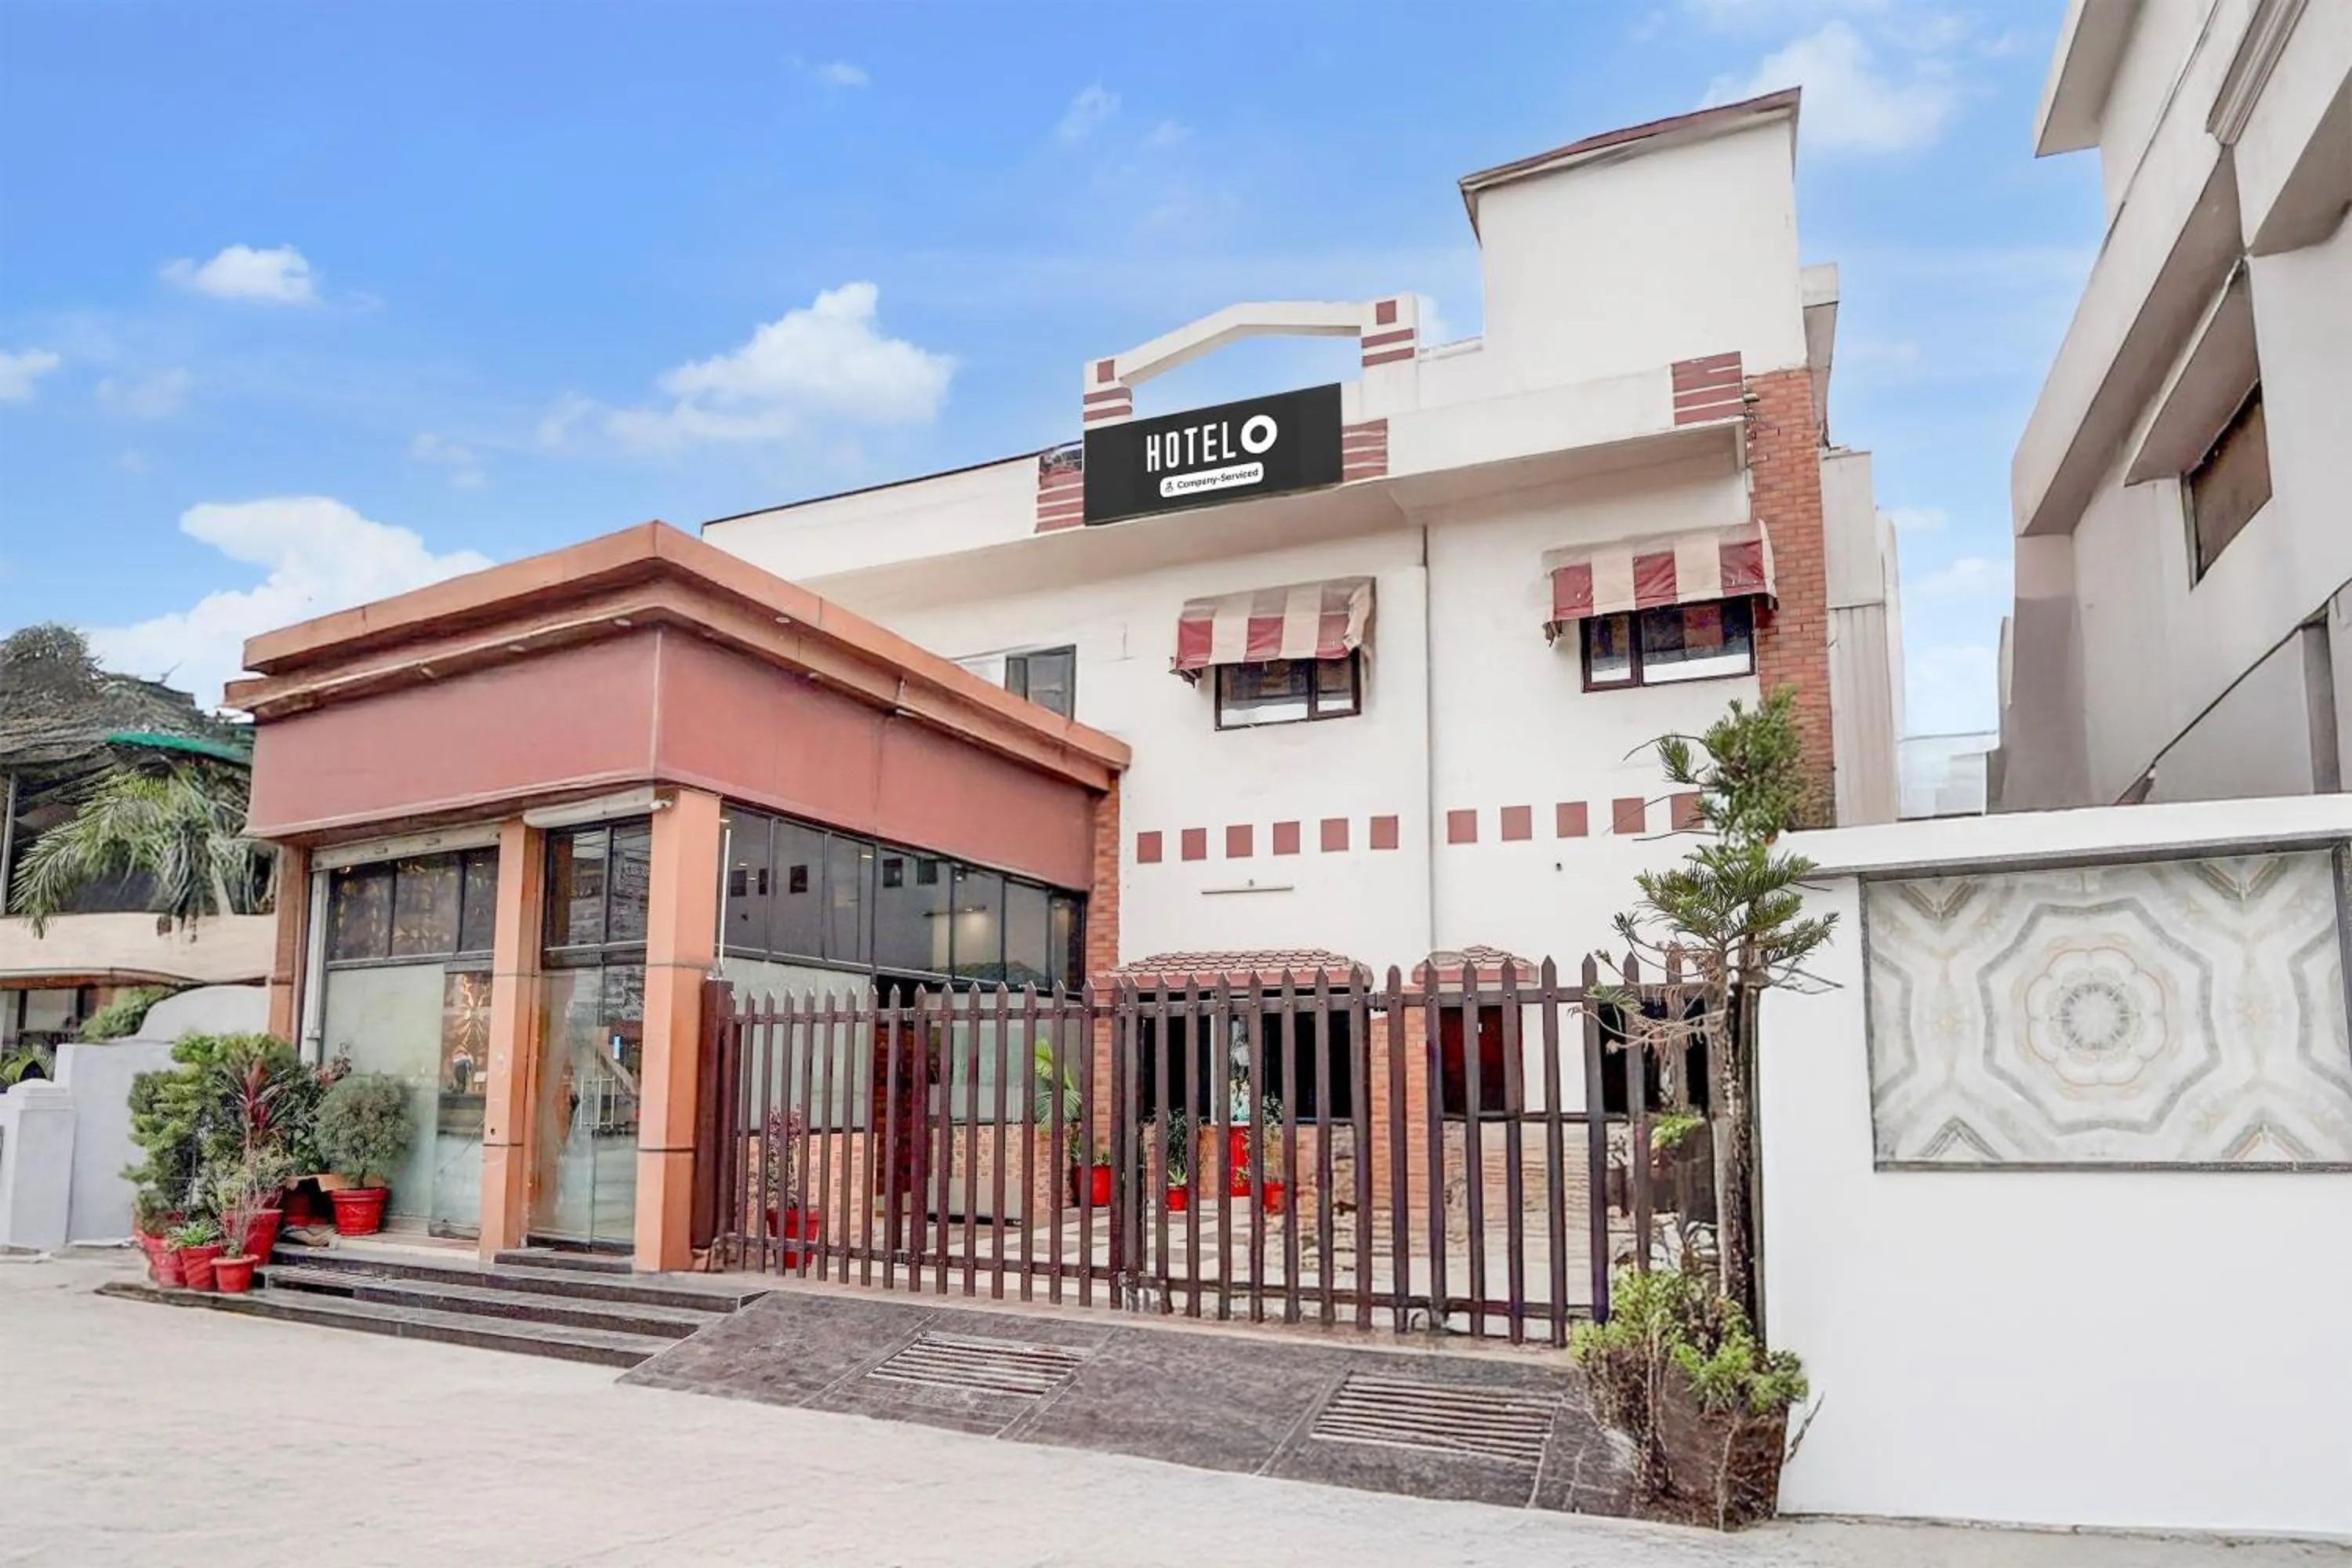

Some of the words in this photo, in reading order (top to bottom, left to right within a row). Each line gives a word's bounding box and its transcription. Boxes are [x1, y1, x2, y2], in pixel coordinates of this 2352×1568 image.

[1146, 421, 1236, 473] HOTEL
[1240, 415, 1278, 454] O
[1177, 468, 1259, 489] Company-Serviced
